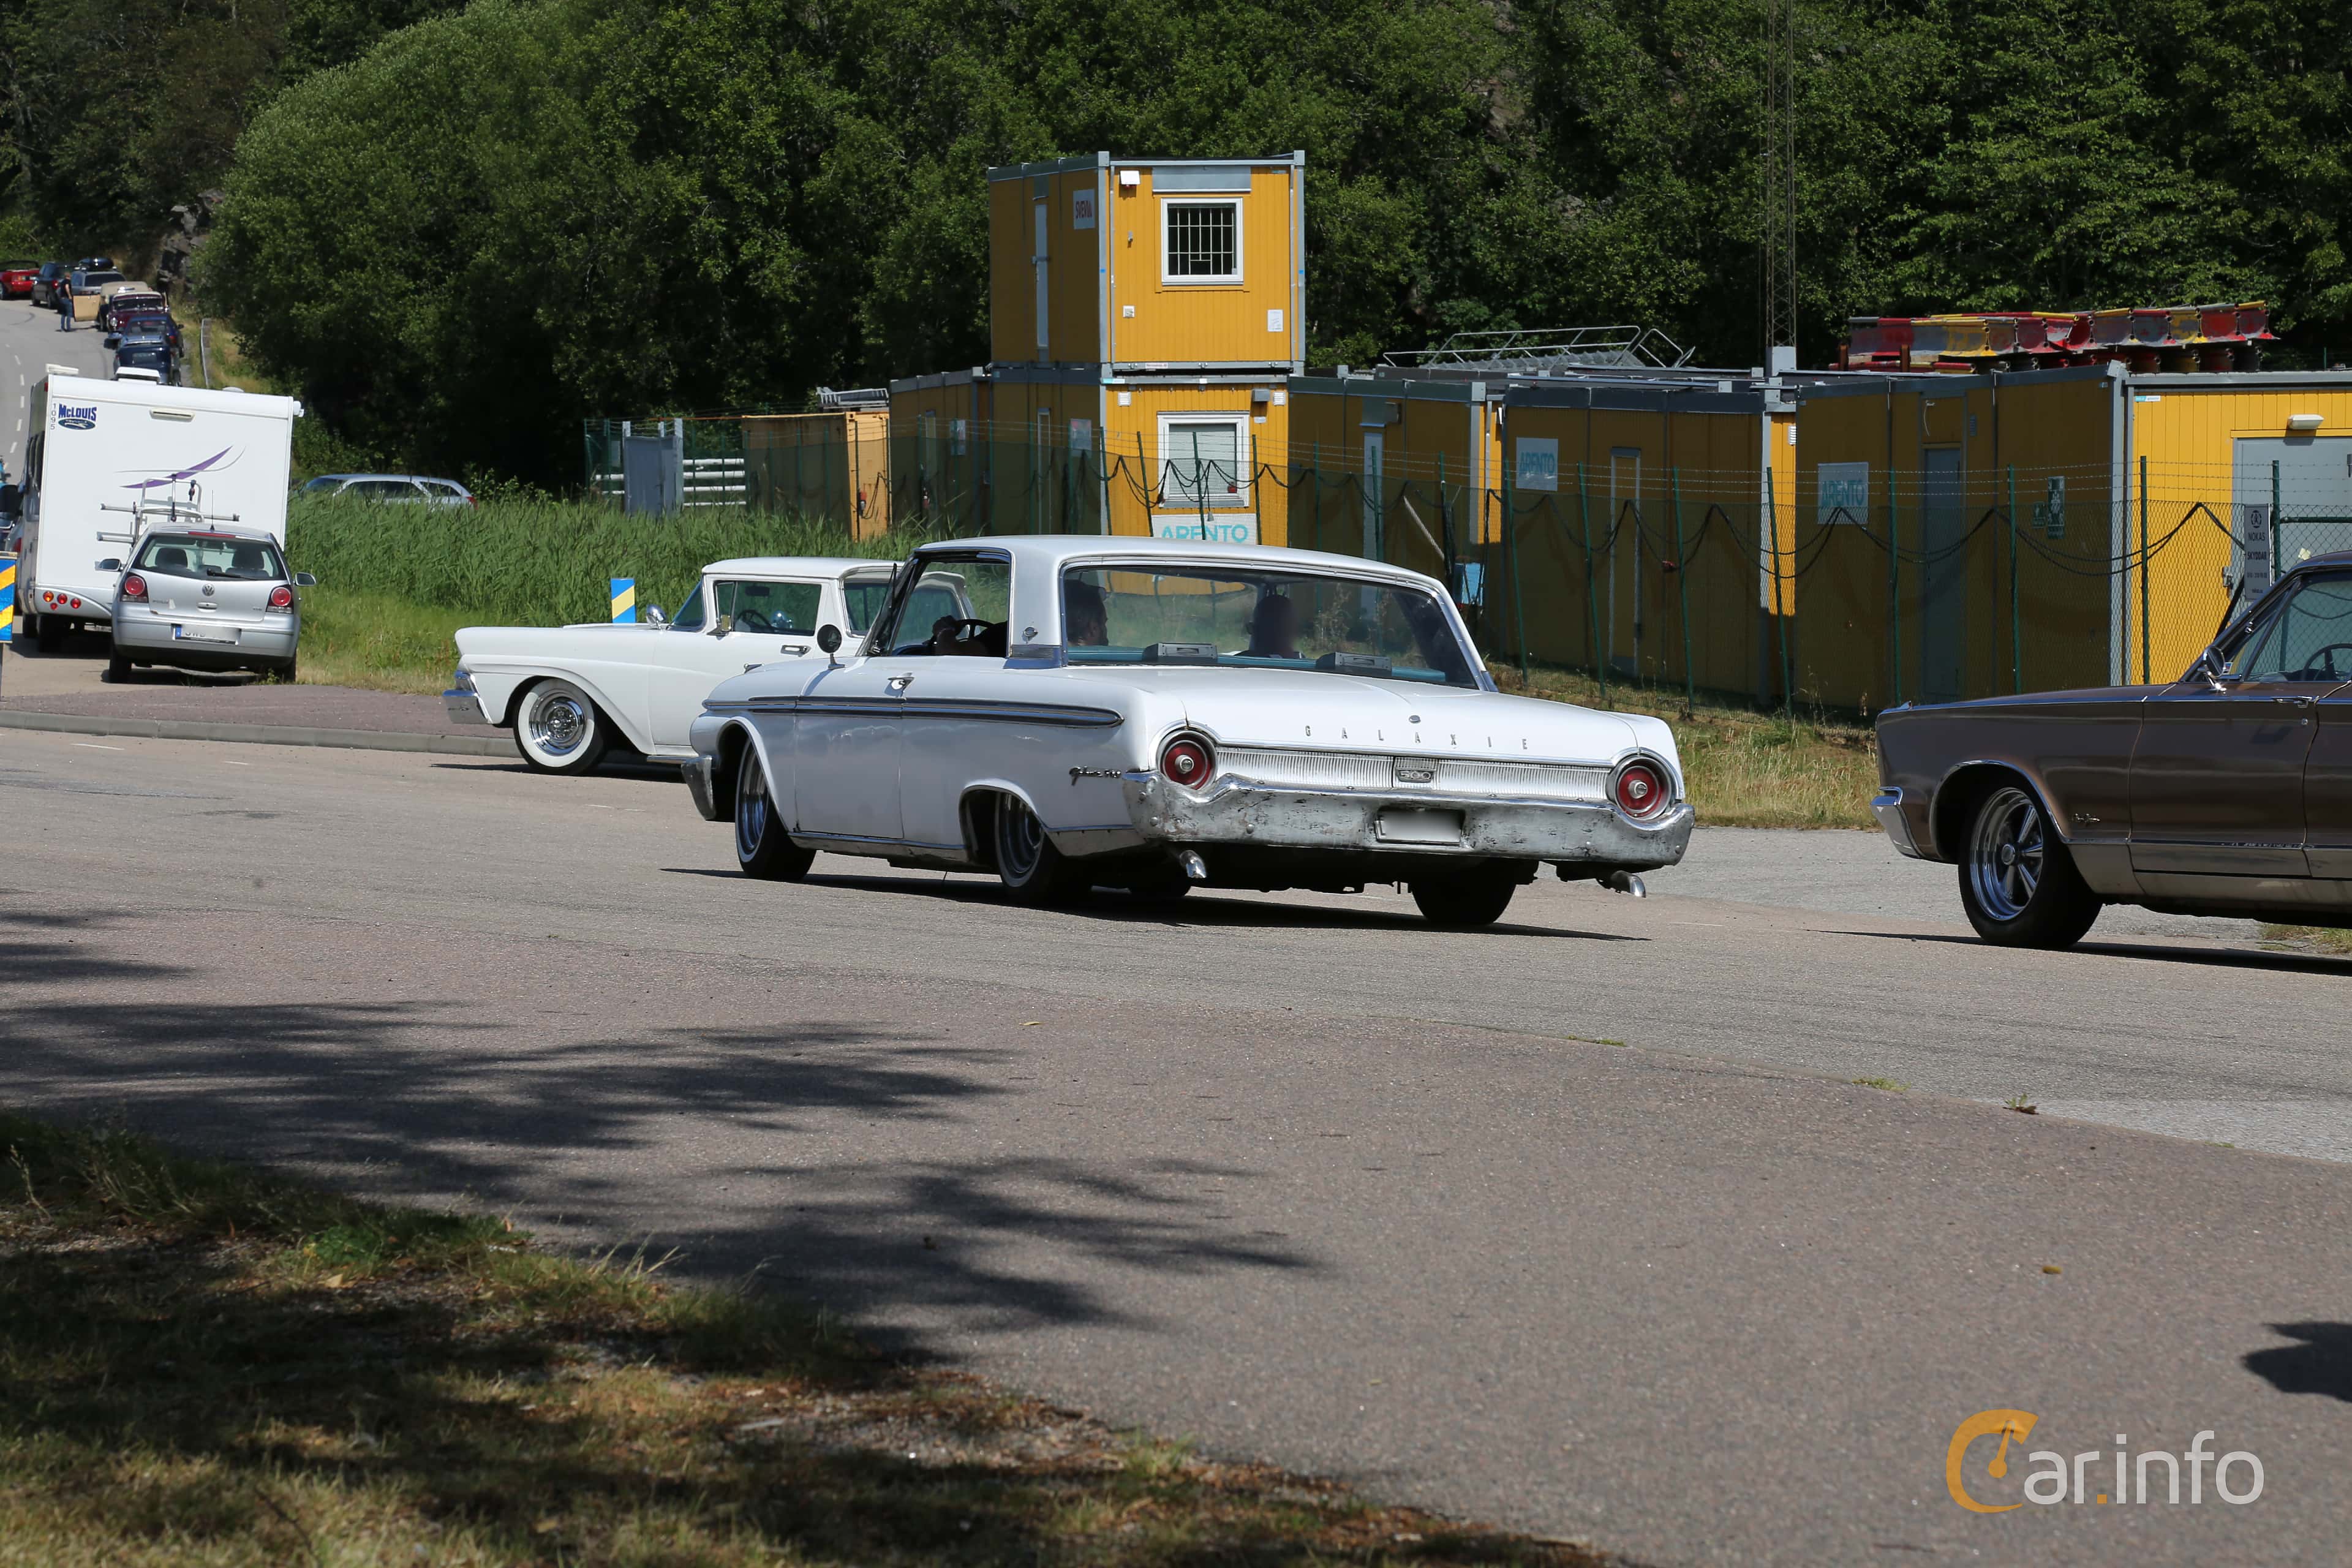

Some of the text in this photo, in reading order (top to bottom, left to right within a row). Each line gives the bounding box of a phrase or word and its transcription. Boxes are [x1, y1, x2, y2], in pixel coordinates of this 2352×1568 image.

[58, 403, 97, 421] McLOUIS
[1305, 725, 1528, 750] GALAXIE
[1401, 770, 1431, 780] 500
